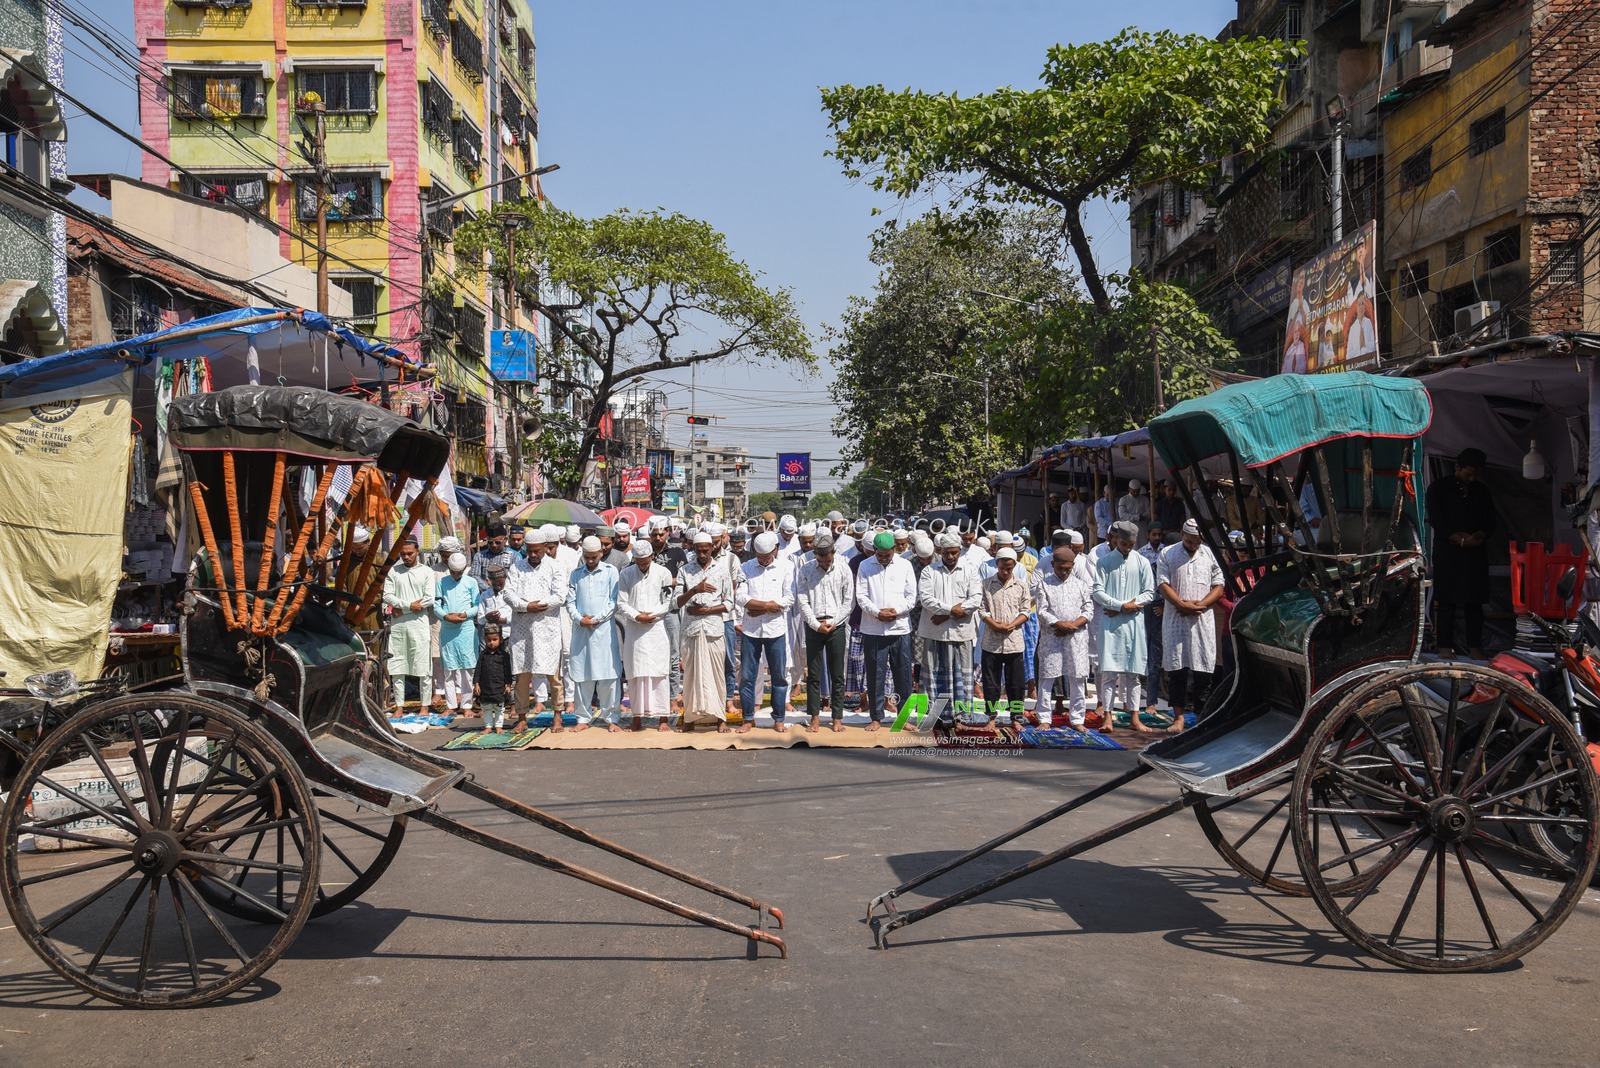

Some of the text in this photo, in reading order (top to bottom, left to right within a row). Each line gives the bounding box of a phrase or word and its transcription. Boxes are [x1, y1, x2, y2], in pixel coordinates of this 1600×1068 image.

[31, 422, 46, 430] SINCE
[19, 428, 39, 437] HOME
[41, 431, 73, 443] TEXTILES
[16, 436, 36, 444] QUALITY
[41, 440, 68, 449] LAVENDER
[780, 473, 809, 482] Baazar
